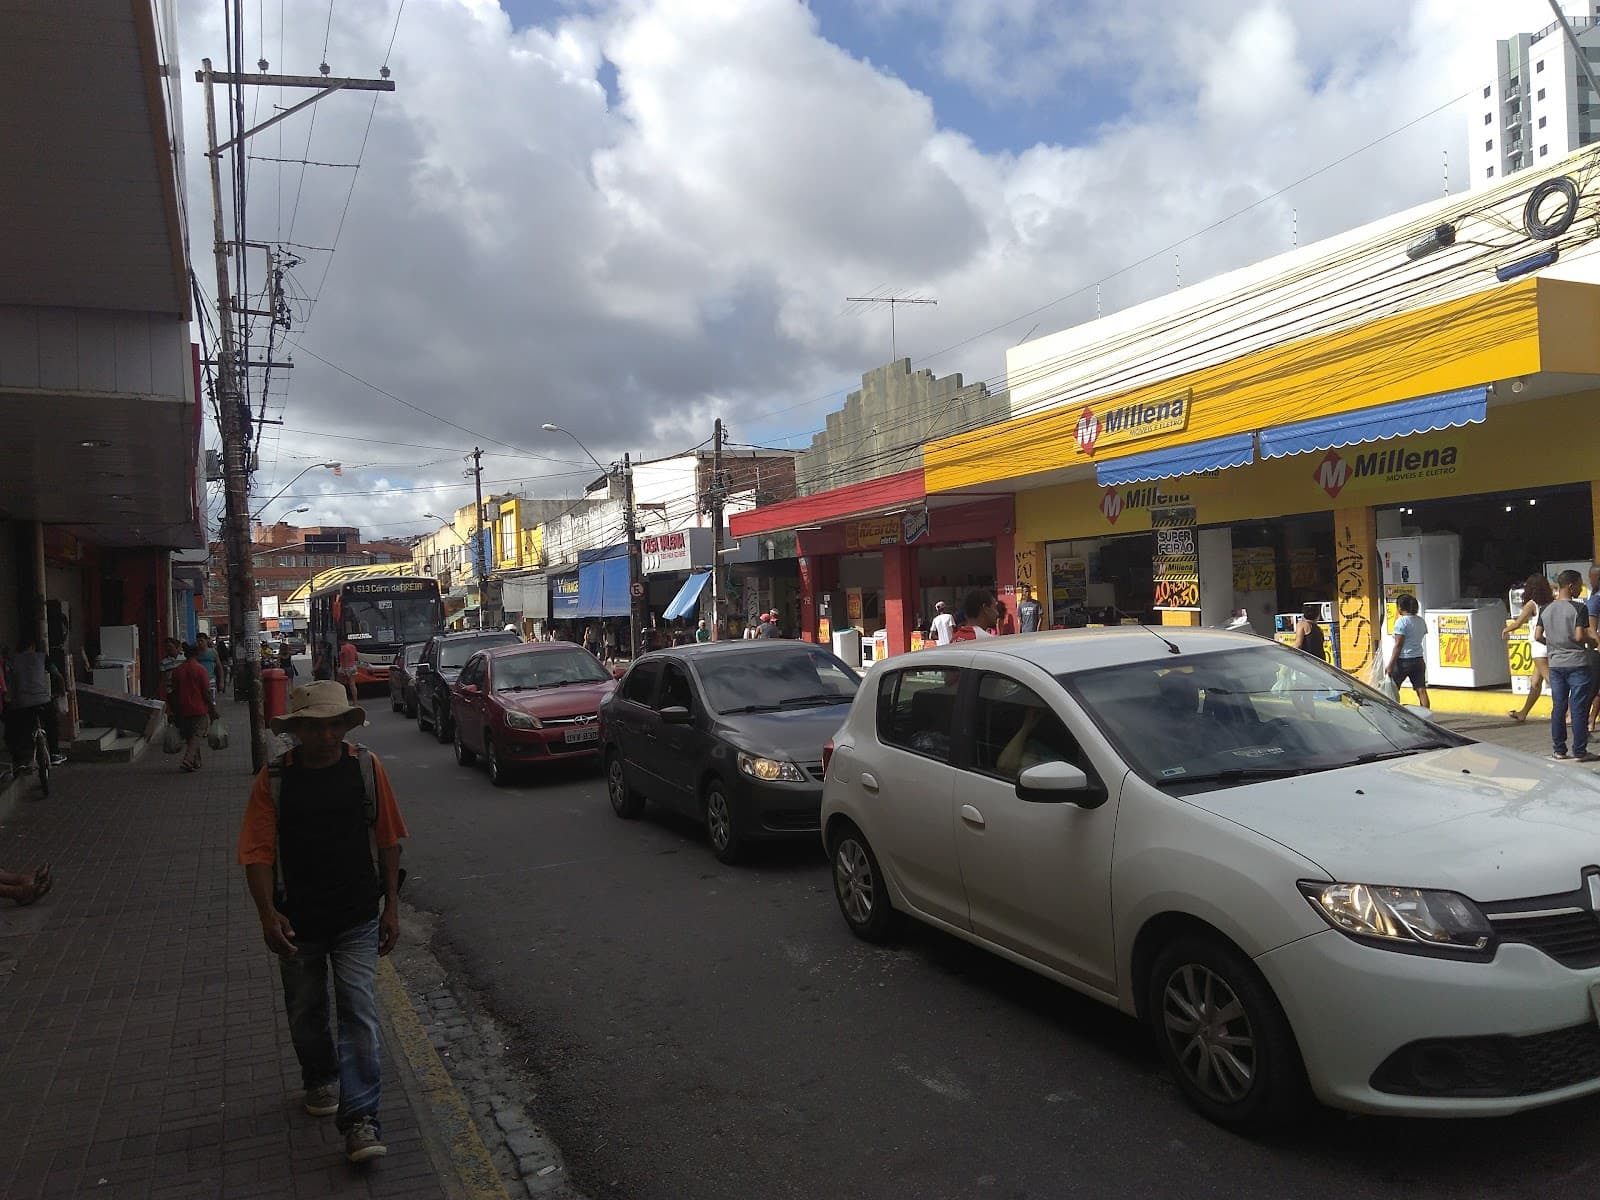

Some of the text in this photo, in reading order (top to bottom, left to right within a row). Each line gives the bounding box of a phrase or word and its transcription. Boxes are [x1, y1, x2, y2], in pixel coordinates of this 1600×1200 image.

[1105, 399, 1184, 433] Millena
[1355, 446, 1458, 477] Millena
[1426, 467, 1456, 477] ELETRO
[1158, 530, 1192, 542] SUPER
